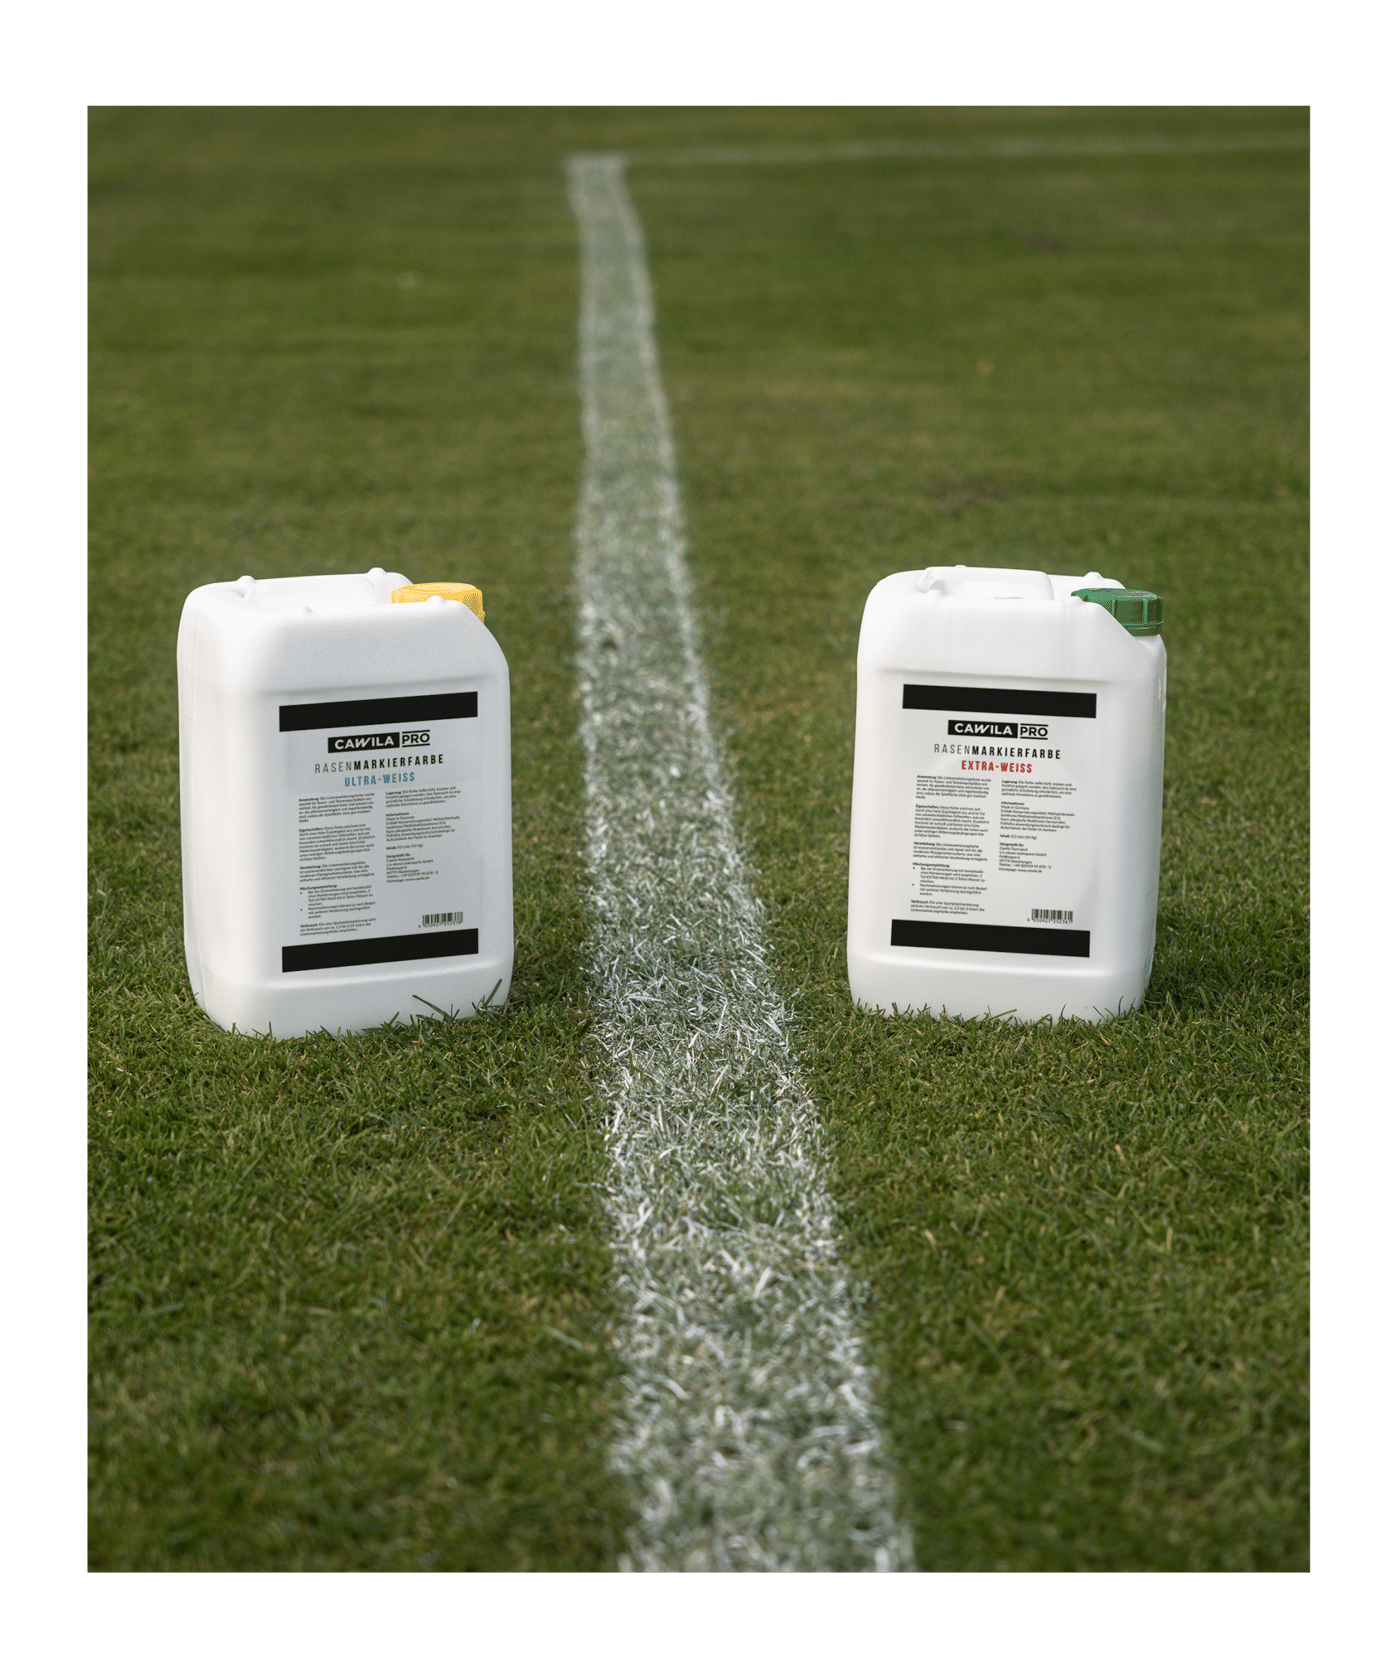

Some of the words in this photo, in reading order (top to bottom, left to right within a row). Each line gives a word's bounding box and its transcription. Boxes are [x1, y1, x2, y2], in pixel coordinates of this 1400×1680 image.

[954, 723, 1013, 735] CAWILA
[1020, 727, 1047, 737] PRO
[334, 735, 394, 750] CAWILA
[402, 733, 430, 744] PRO
[934, 744, 1061, 759] RASENMARKIERFARBE
[315, 754, 444, 773] RASENMARKIERFARBE
[961, 760, 1032, 773] EXTRA-WEISS
[344, 772, 415, 787] ULTRA-WEISS
